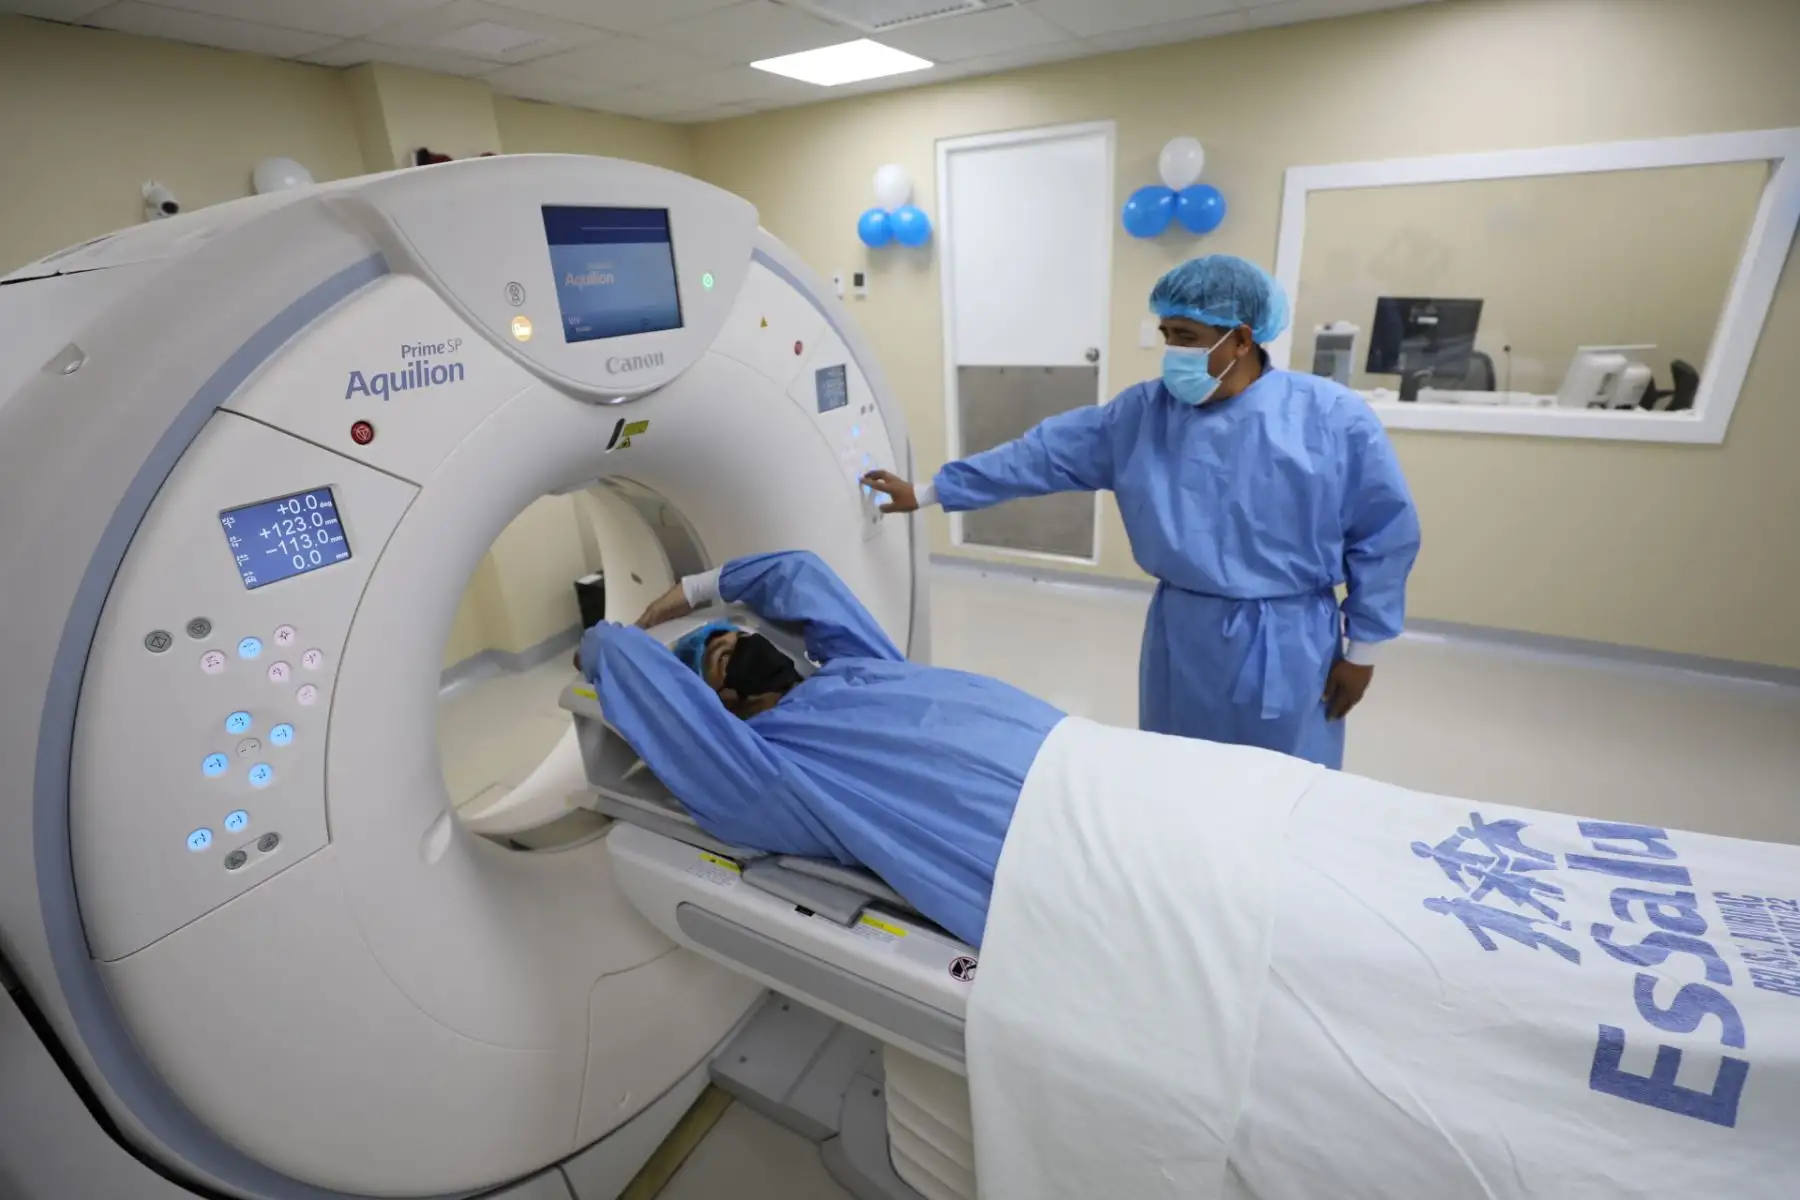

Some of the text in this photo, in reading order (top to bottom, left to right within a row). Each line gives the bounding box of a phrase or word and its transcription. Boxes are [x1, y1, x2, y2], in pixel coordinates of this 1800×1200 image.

[565, 271, 614, 291] Aquilion
[401, 338, 462, 358] Prime SP
[605, 351, 665, 375] Canon
[345, 360, 464, 401] Aquilion
[277, 494, 317, 515] +0.0
[260, 512, 323, 539] +123.0
[293, 550, 322, 570] 0.0
[1564, 820, 1750, 1129] EsSalu
